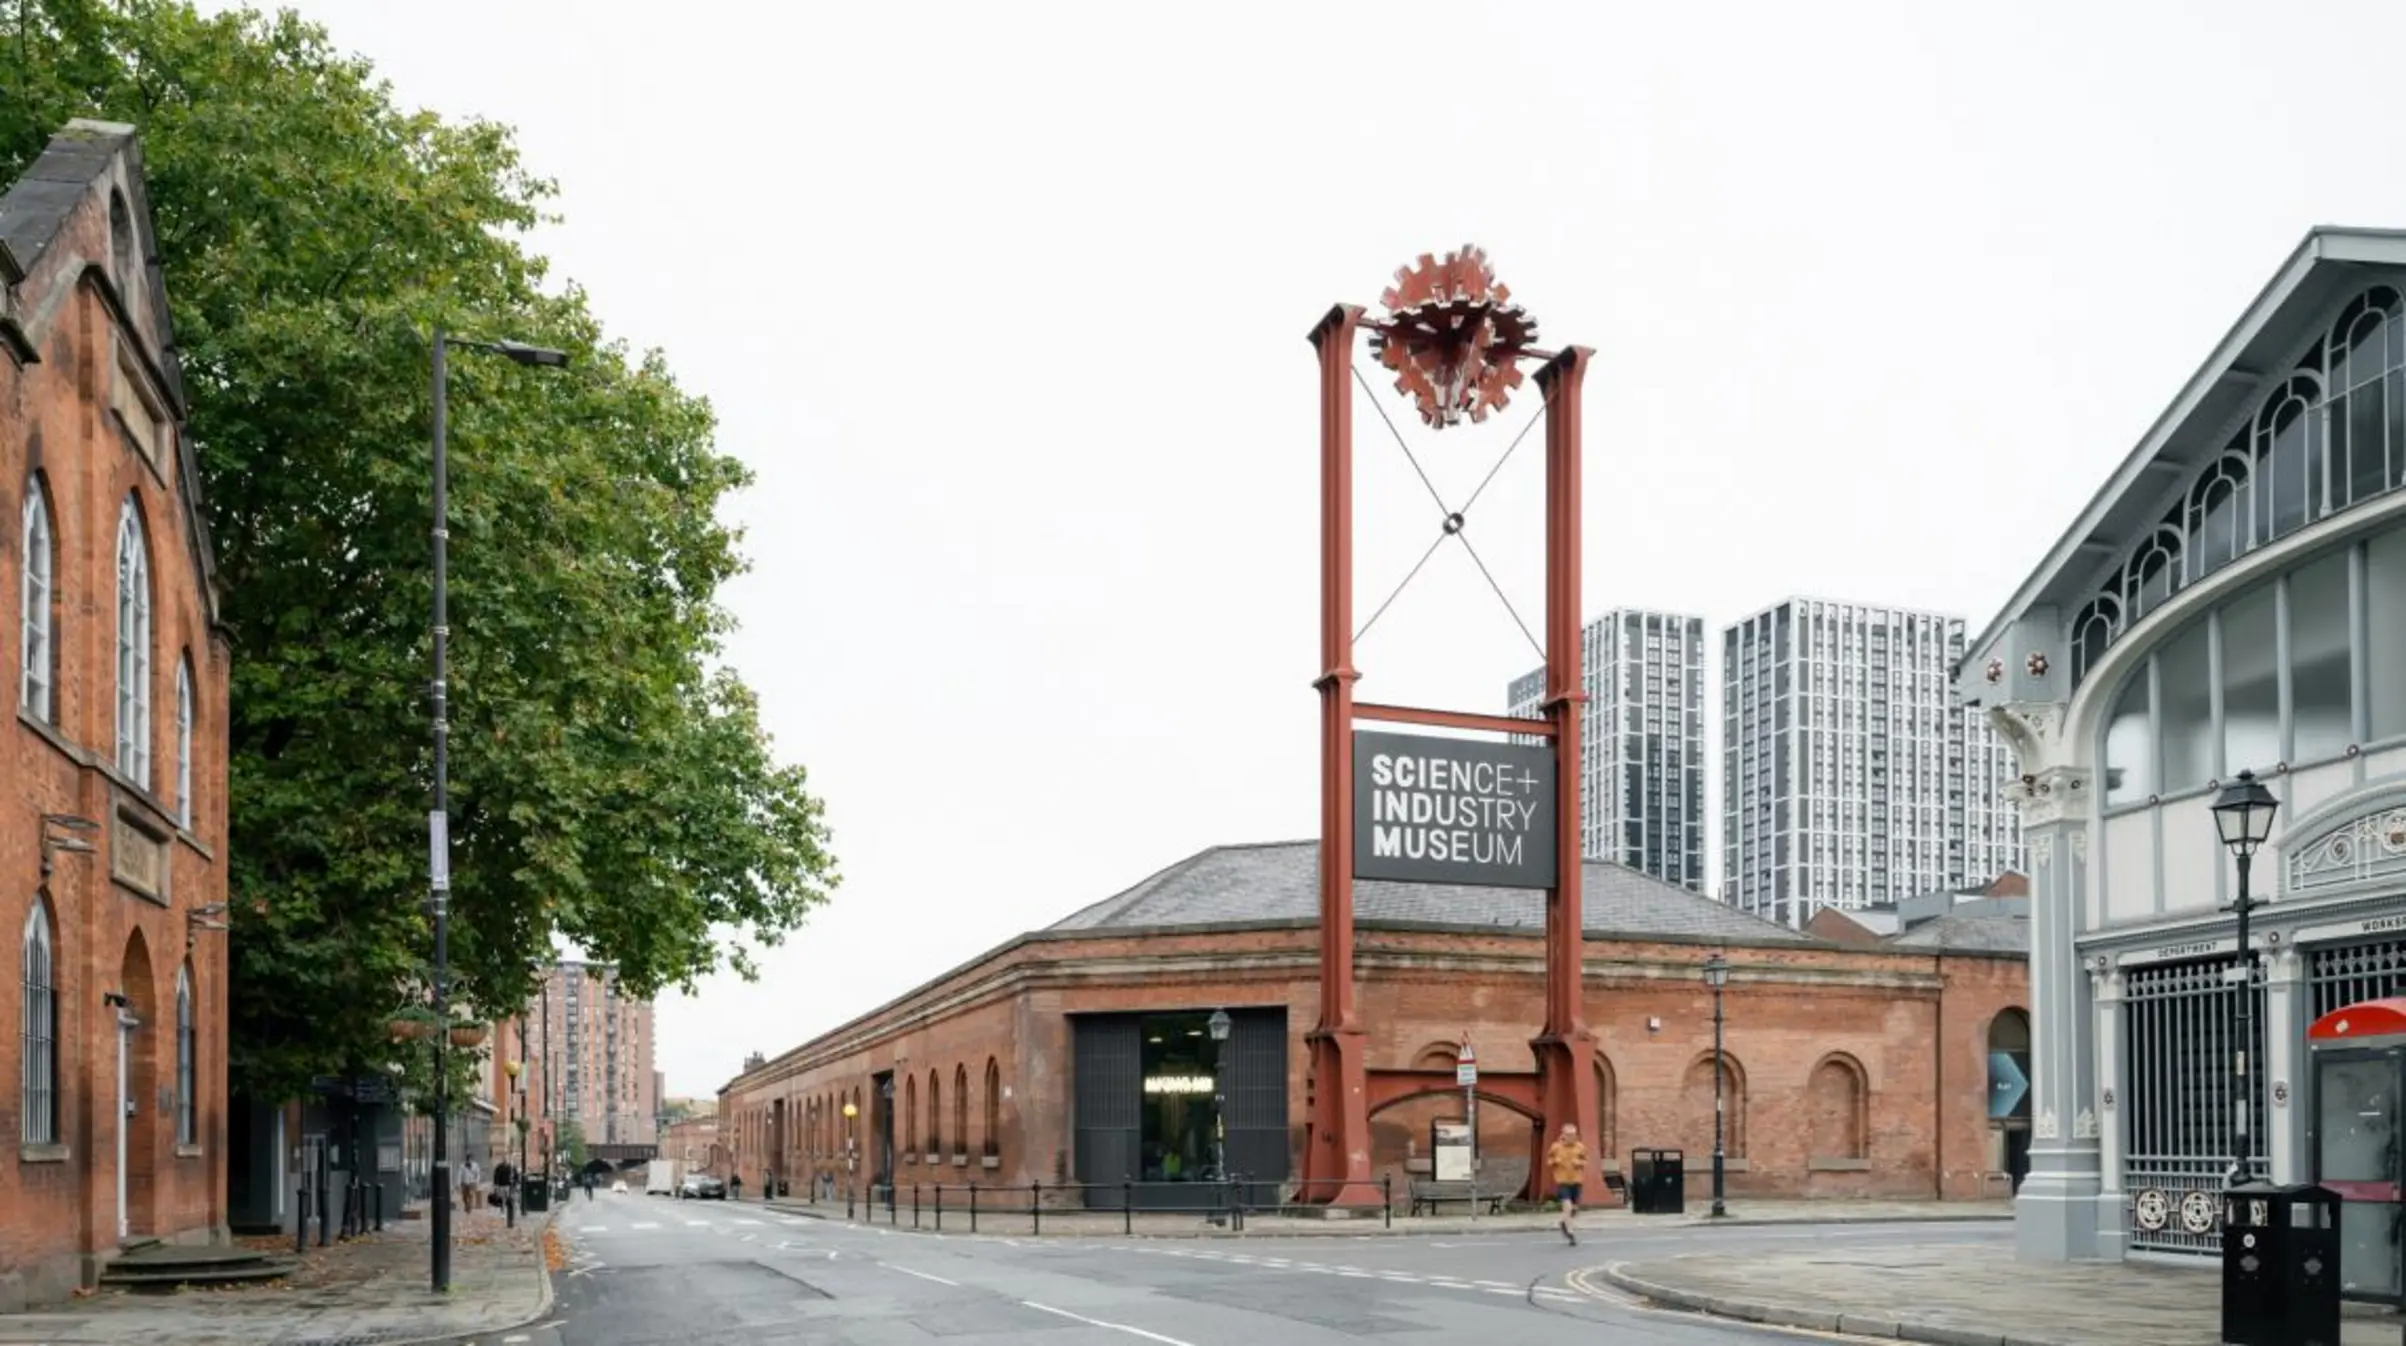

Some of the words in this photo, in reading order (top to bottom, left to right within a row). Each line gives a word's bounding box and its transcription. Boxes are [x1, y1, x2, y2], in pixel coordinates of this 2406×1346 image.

[1371, 753, 1539, 796] SCIENCE+
[1373, 789, 1537, 831] INDUSTRY
[1373, 824, 1522, 866] MUSEUM
[2157, 941, 2218, 958] DEPARTMENT
